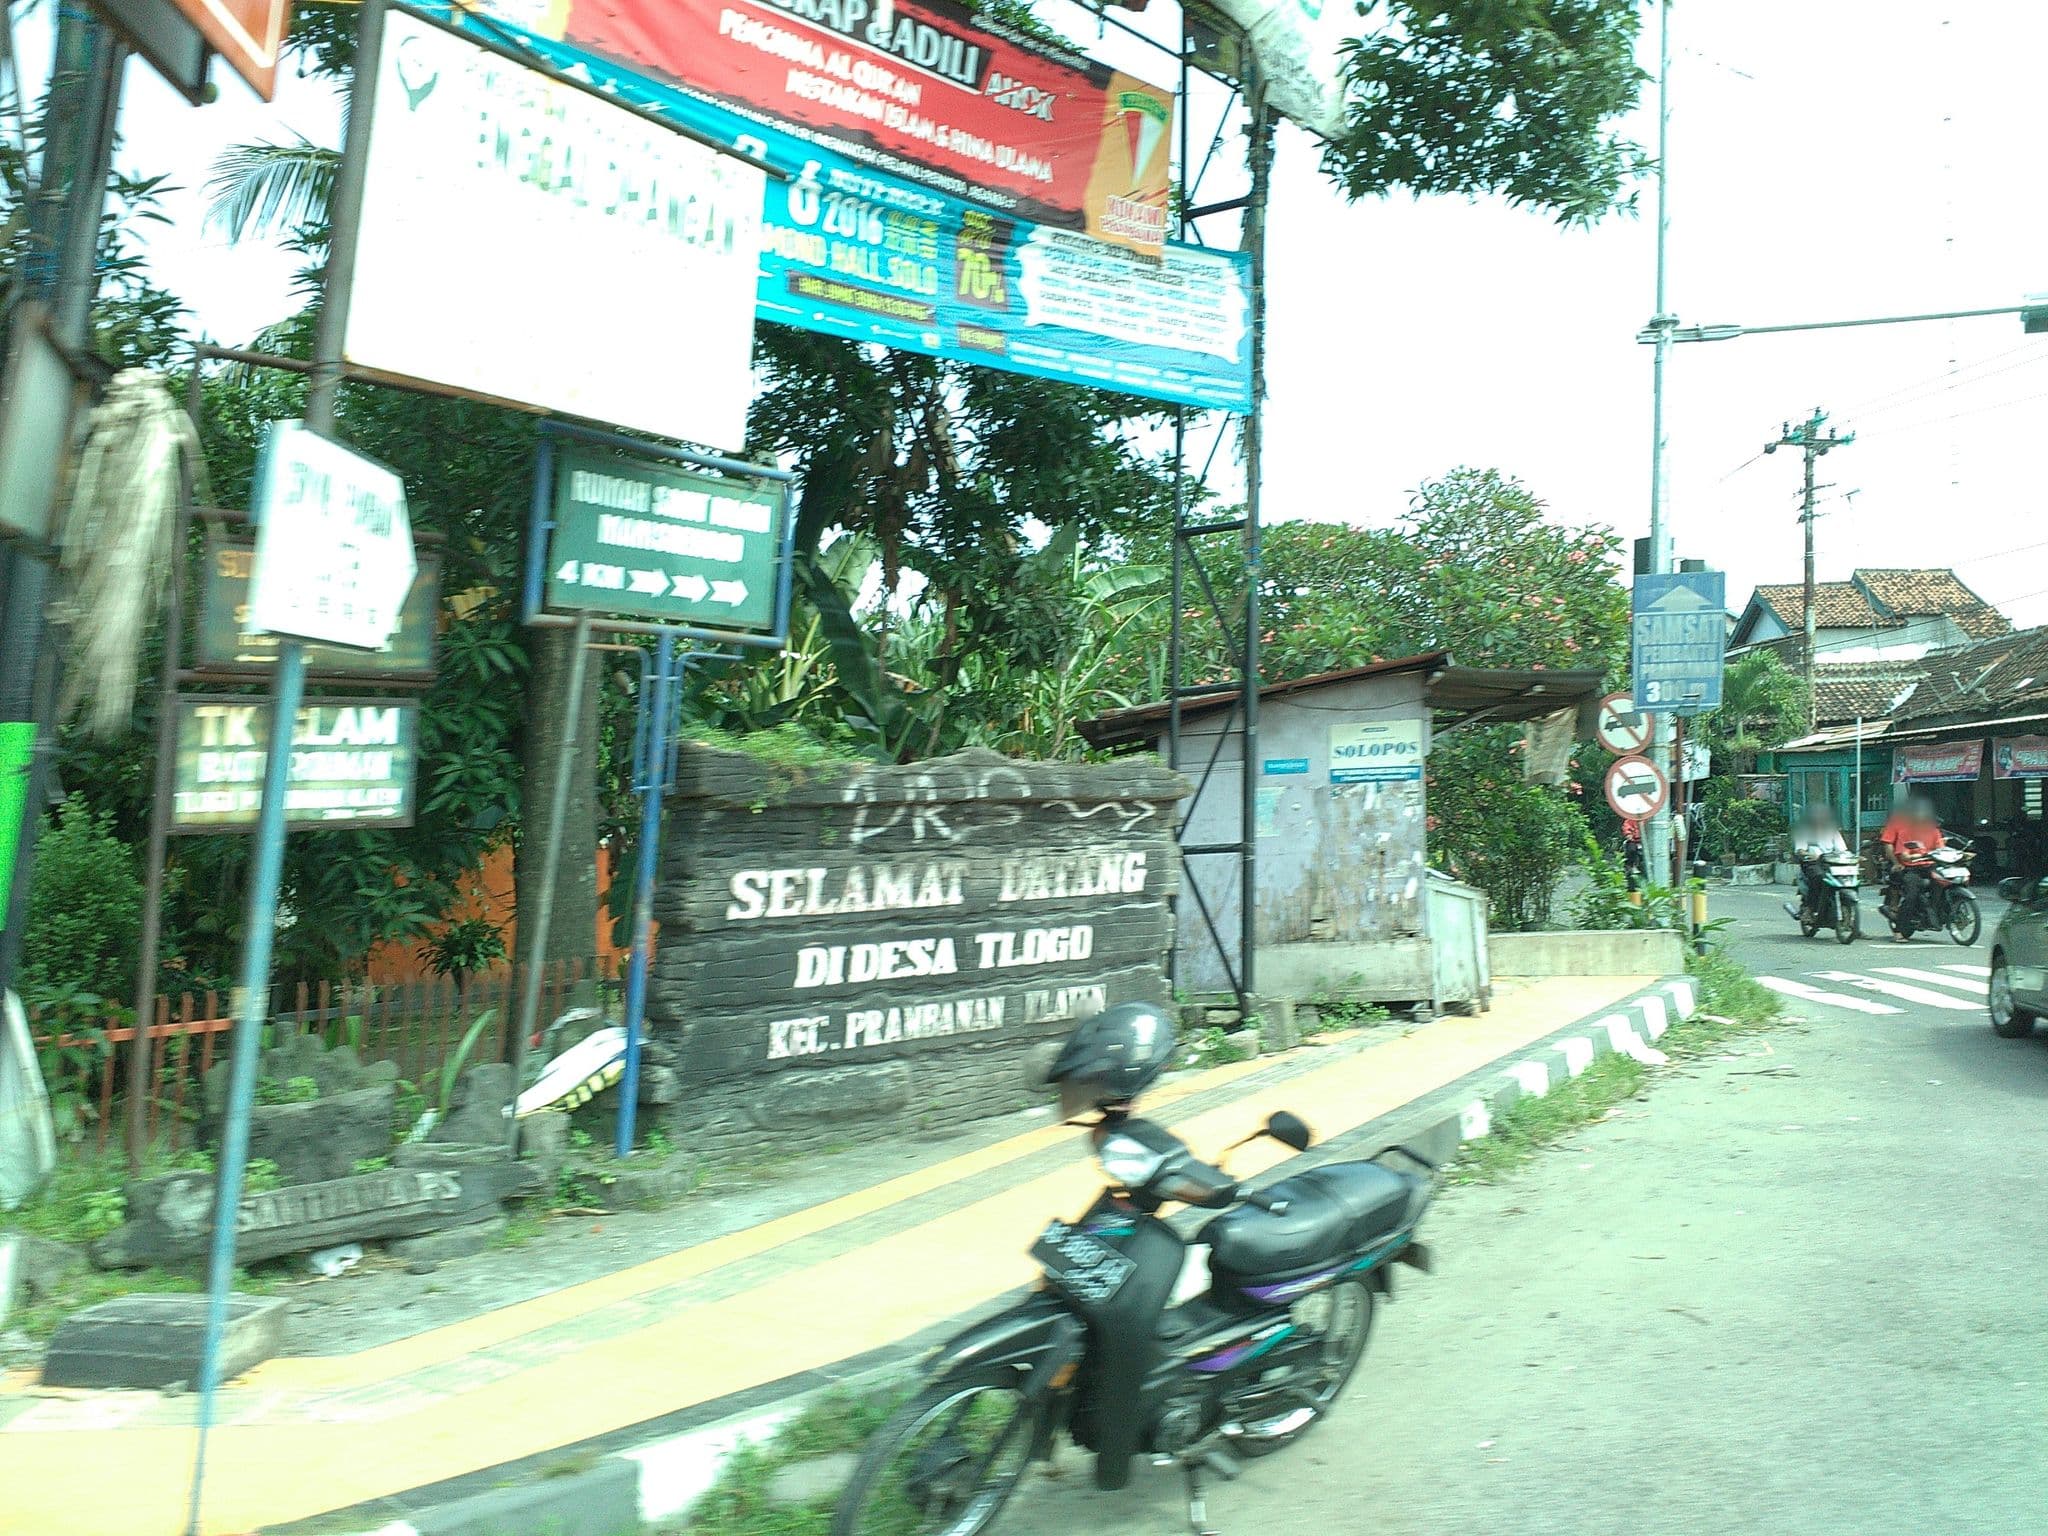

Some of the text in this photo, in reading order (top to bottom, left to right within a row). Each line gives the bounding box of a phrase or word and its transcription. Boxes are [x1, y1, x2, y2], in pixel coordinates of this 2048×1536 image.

[890, 18, 980, 84] ADILI
[823, 192, 885, 246] 2016
[556, 560, 580, 584] 4
[194, 706, 258, 746] TK
[1333, 741, 1418, 759] SOLOPOS
[726, 851, 1148, 920] SELAMAT DATANG
[793, 925, 1094, 988] DI DESA TLOGO
[767, 1015, 842, 1059] KEC.
[844, 996, 1006, 1050] PRAMBANAN
